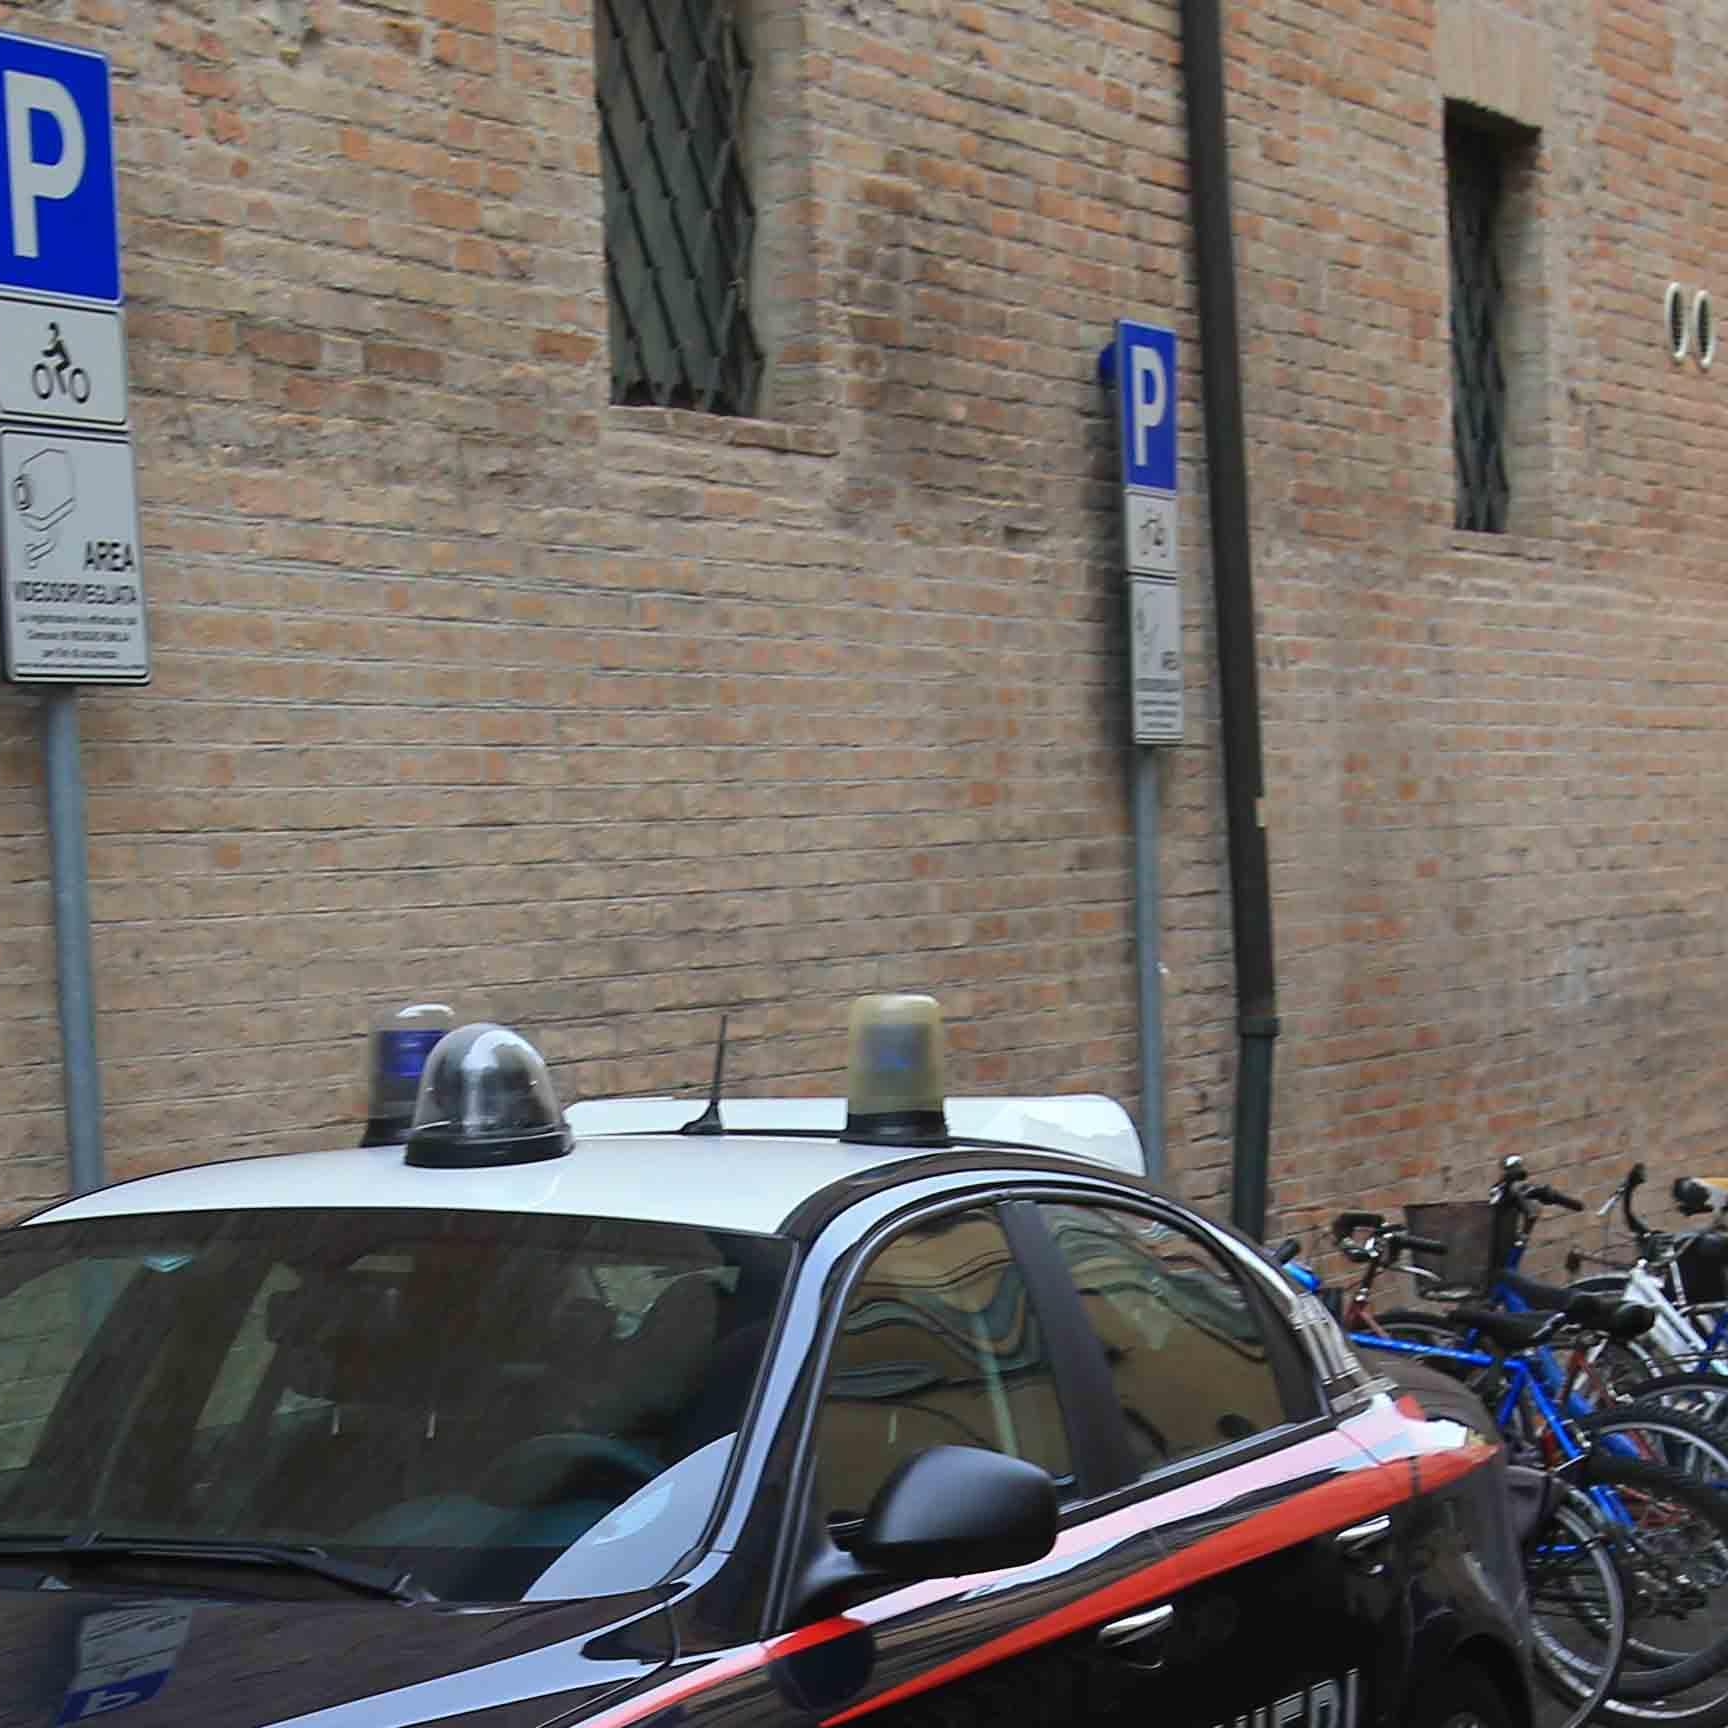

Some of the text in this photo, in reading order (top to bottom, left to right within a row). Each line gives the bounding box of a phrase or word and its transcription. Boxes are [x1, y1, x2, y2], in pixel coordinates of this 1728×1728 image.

[3, 69, 87, 259] P
[1129, 345, 1169, 467] P
[82, 540, 137, 573] AREA
